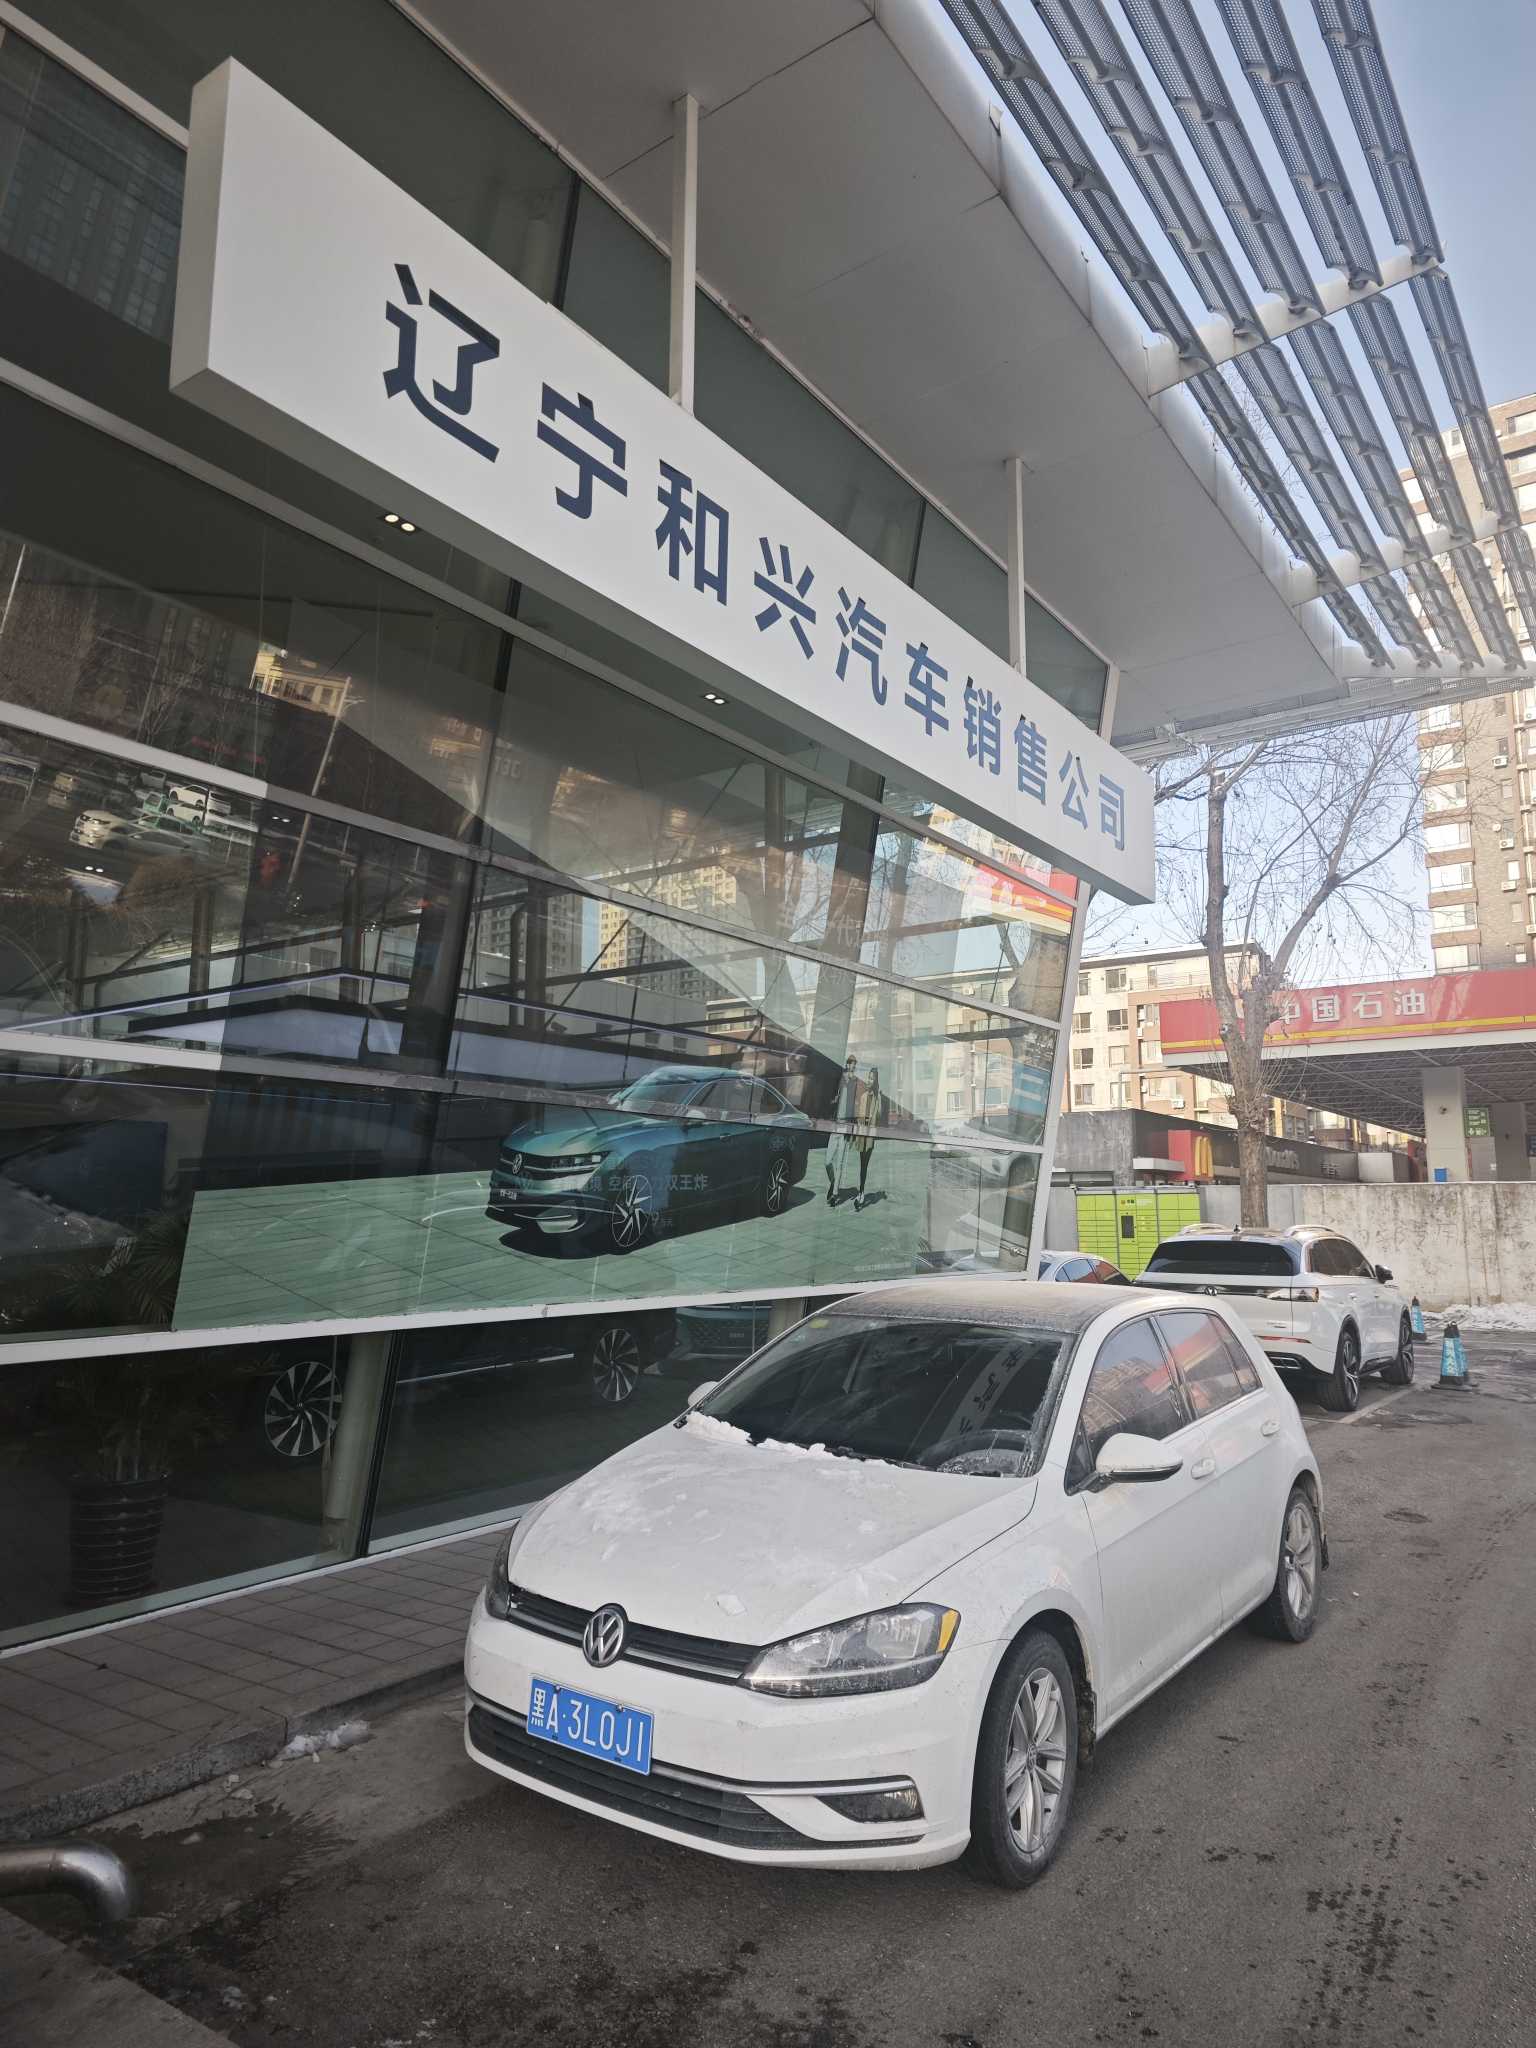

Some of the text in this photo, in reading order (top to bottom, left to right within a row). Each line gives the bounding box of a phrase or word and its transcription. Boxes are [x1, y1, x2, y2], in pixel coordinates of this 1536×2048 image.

[382, 263, 1127, 853] 辽宁和兴汽车销售公司
